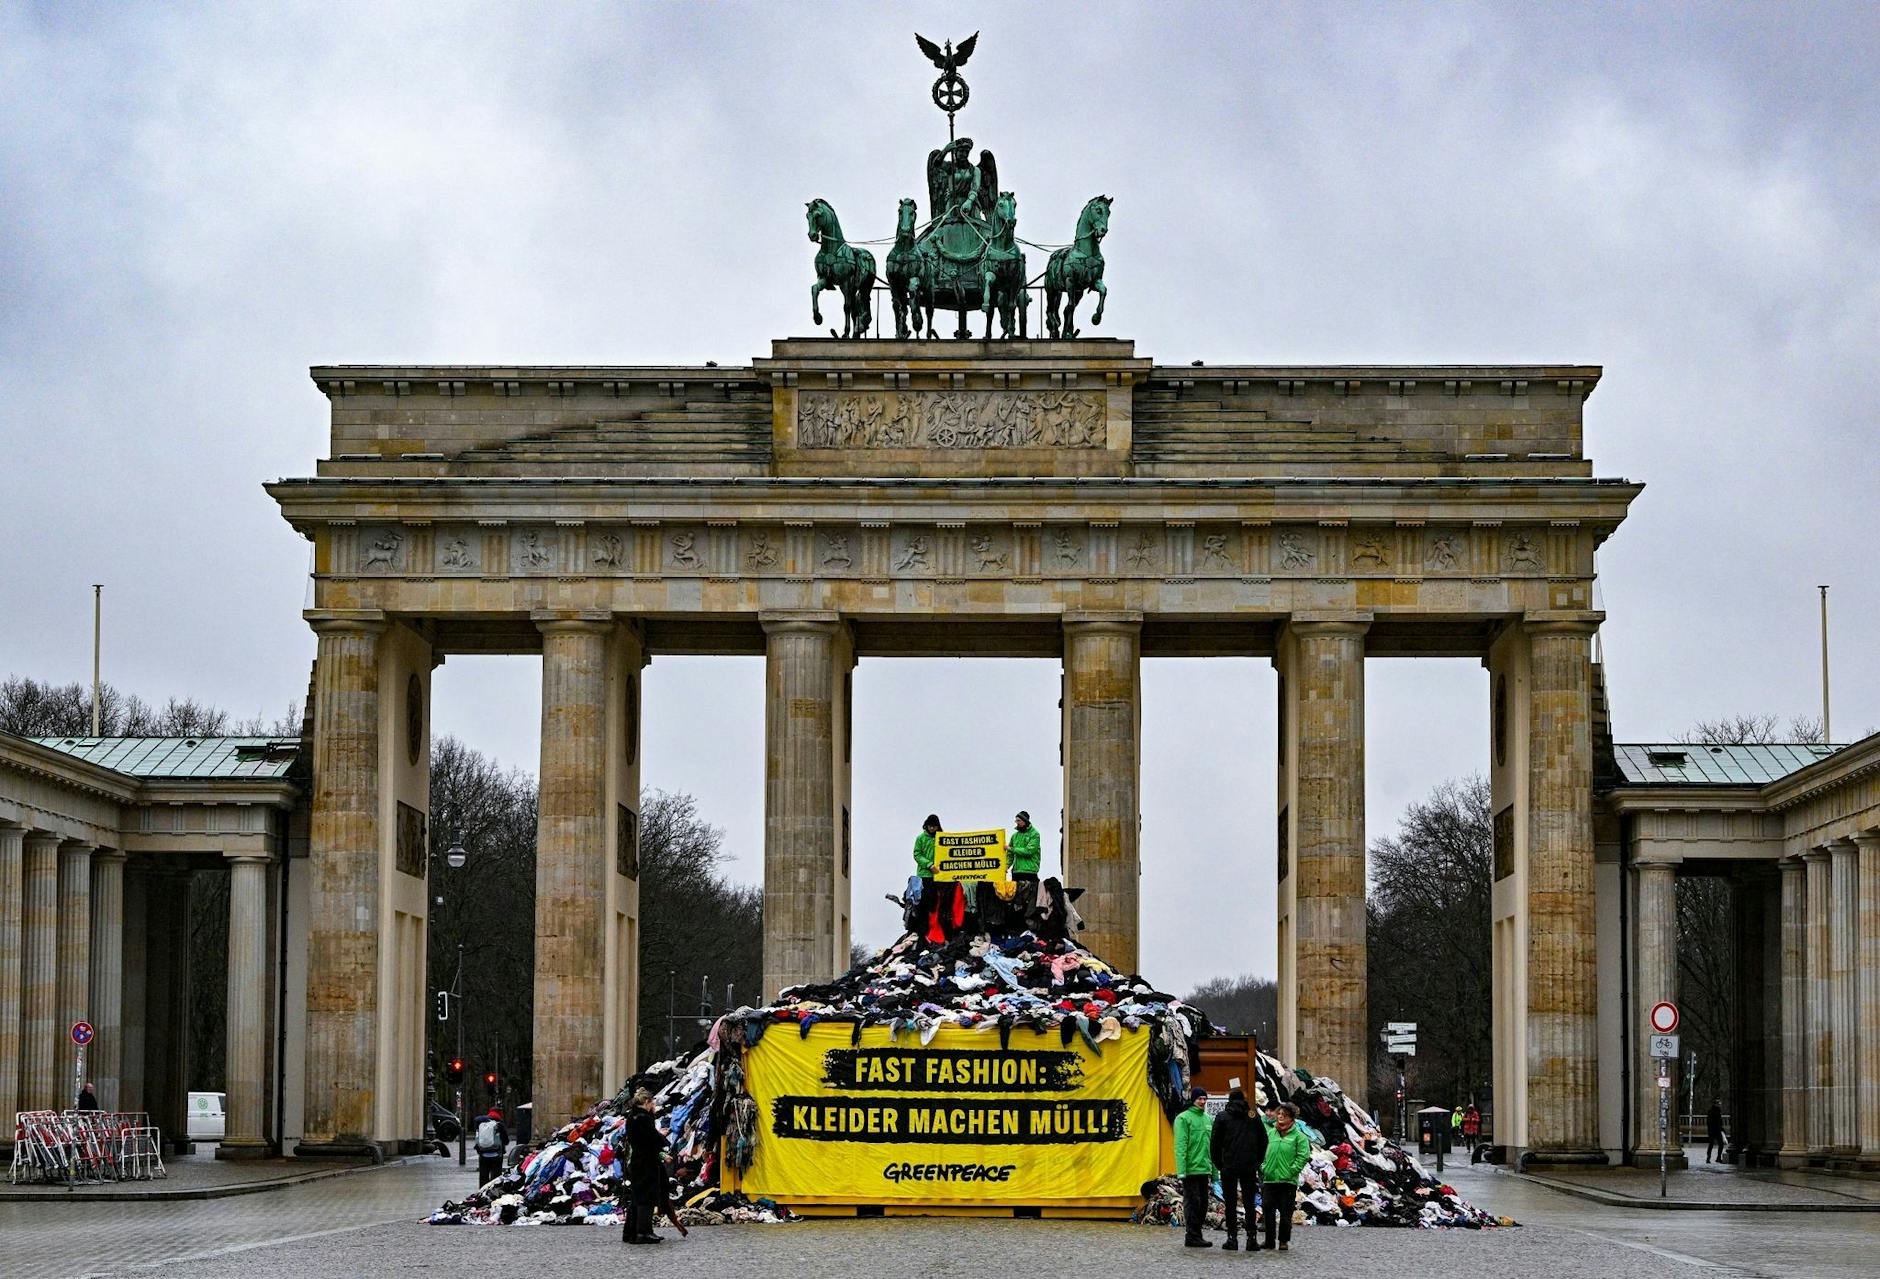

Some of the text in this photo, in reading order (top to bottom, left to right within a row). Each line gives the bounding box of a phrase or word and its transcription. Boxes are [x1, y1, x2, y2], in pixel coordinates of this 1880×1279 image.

[942, 835, 994, 845] FAST FASHION:
[953, 848, 982, 856] KLEIDER
[942, 860, 996, 870] MACHEN MÜLL!
[855, 1057, 1047, 1085] FAST FASHION:
[793, 1104, 1109, 1135] KLEIDER MACHEN MÜLL!
[883, 1163, 1016, 1184] GREENPEACE
